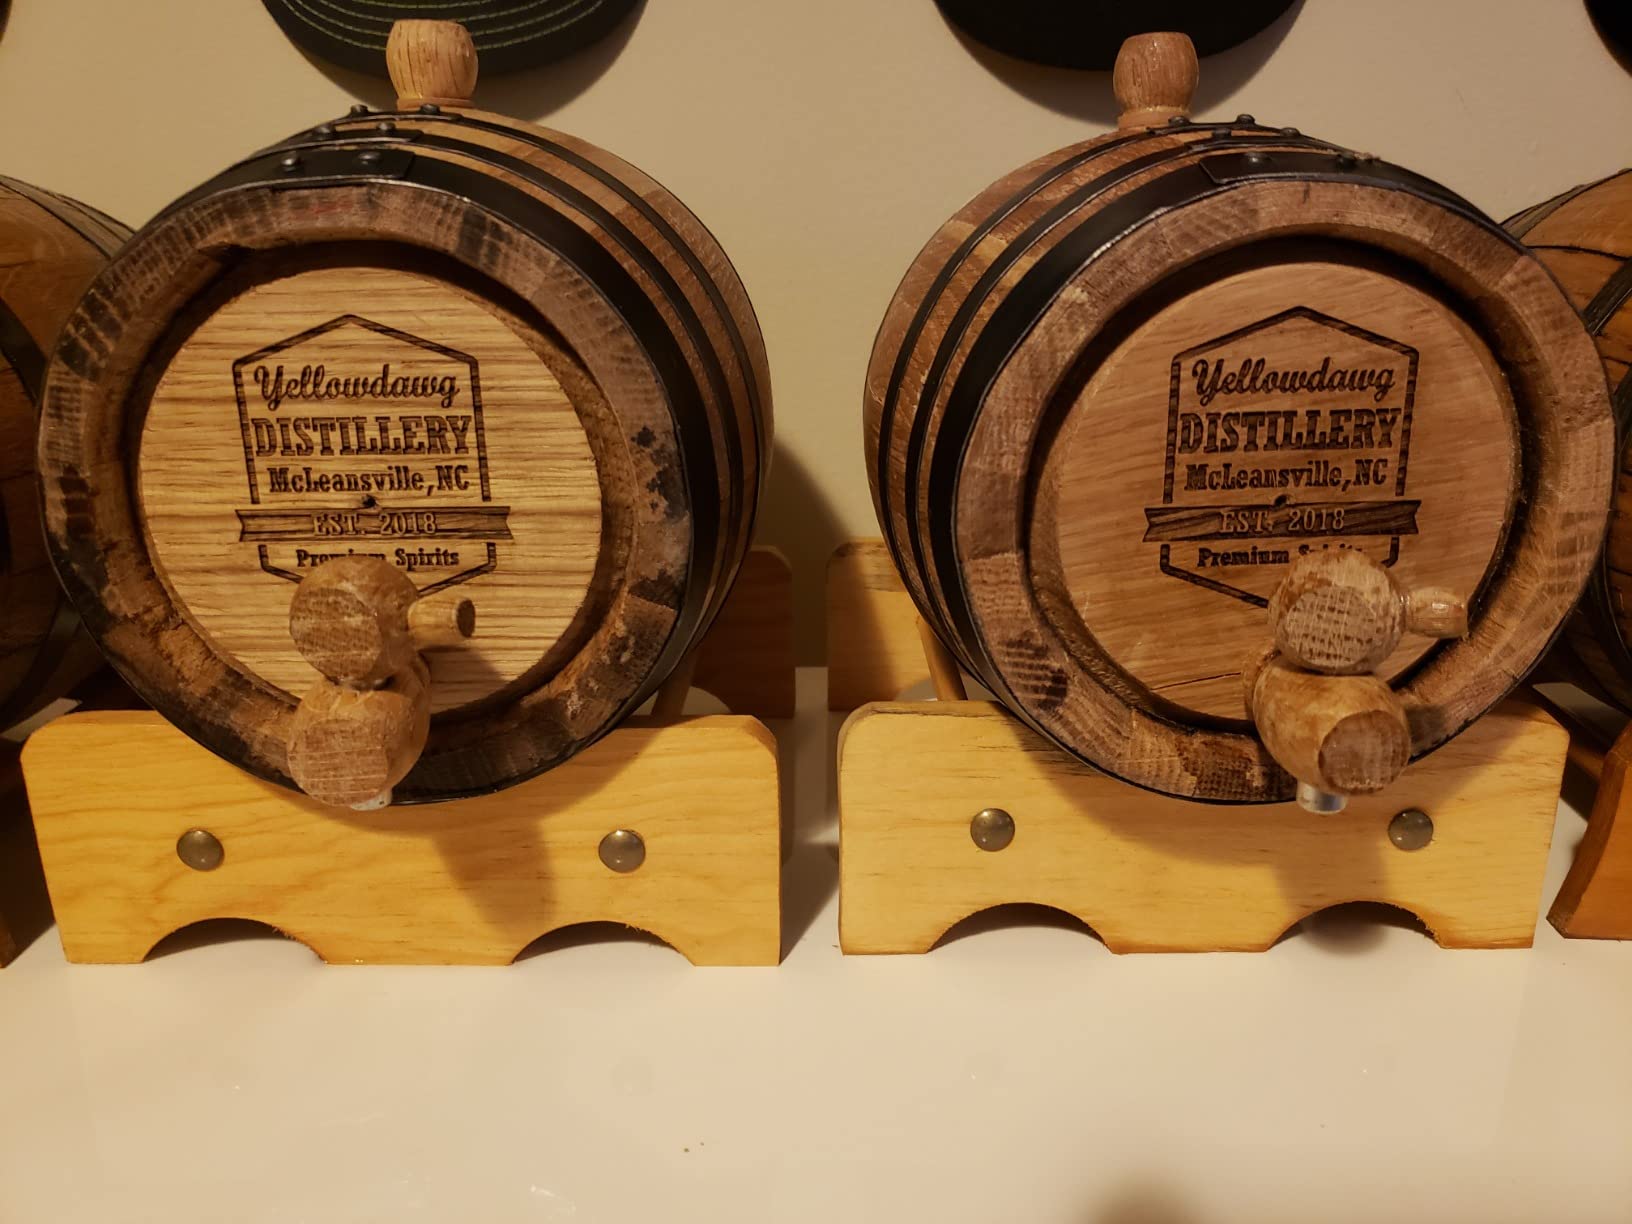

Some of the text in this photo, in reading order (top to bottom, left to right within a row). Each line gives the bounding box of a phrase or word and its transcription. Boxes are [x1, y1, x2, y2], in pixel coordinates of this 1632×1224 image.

[253, 363, 460, 411] Yellowdawg
[1191, 357, 1395, 407] Yellowdawg
[251, 415, 473, 457] DISTILLERY
[1178, 408, 1402, 454] DISTILLERY
[312, 512, 437, 536] EST. 2018
[1219, 507, 1345, 533] EST. 2018
[394, 548, 460, 572] Spirits
[1197, 545, 1290, 567] Premium
